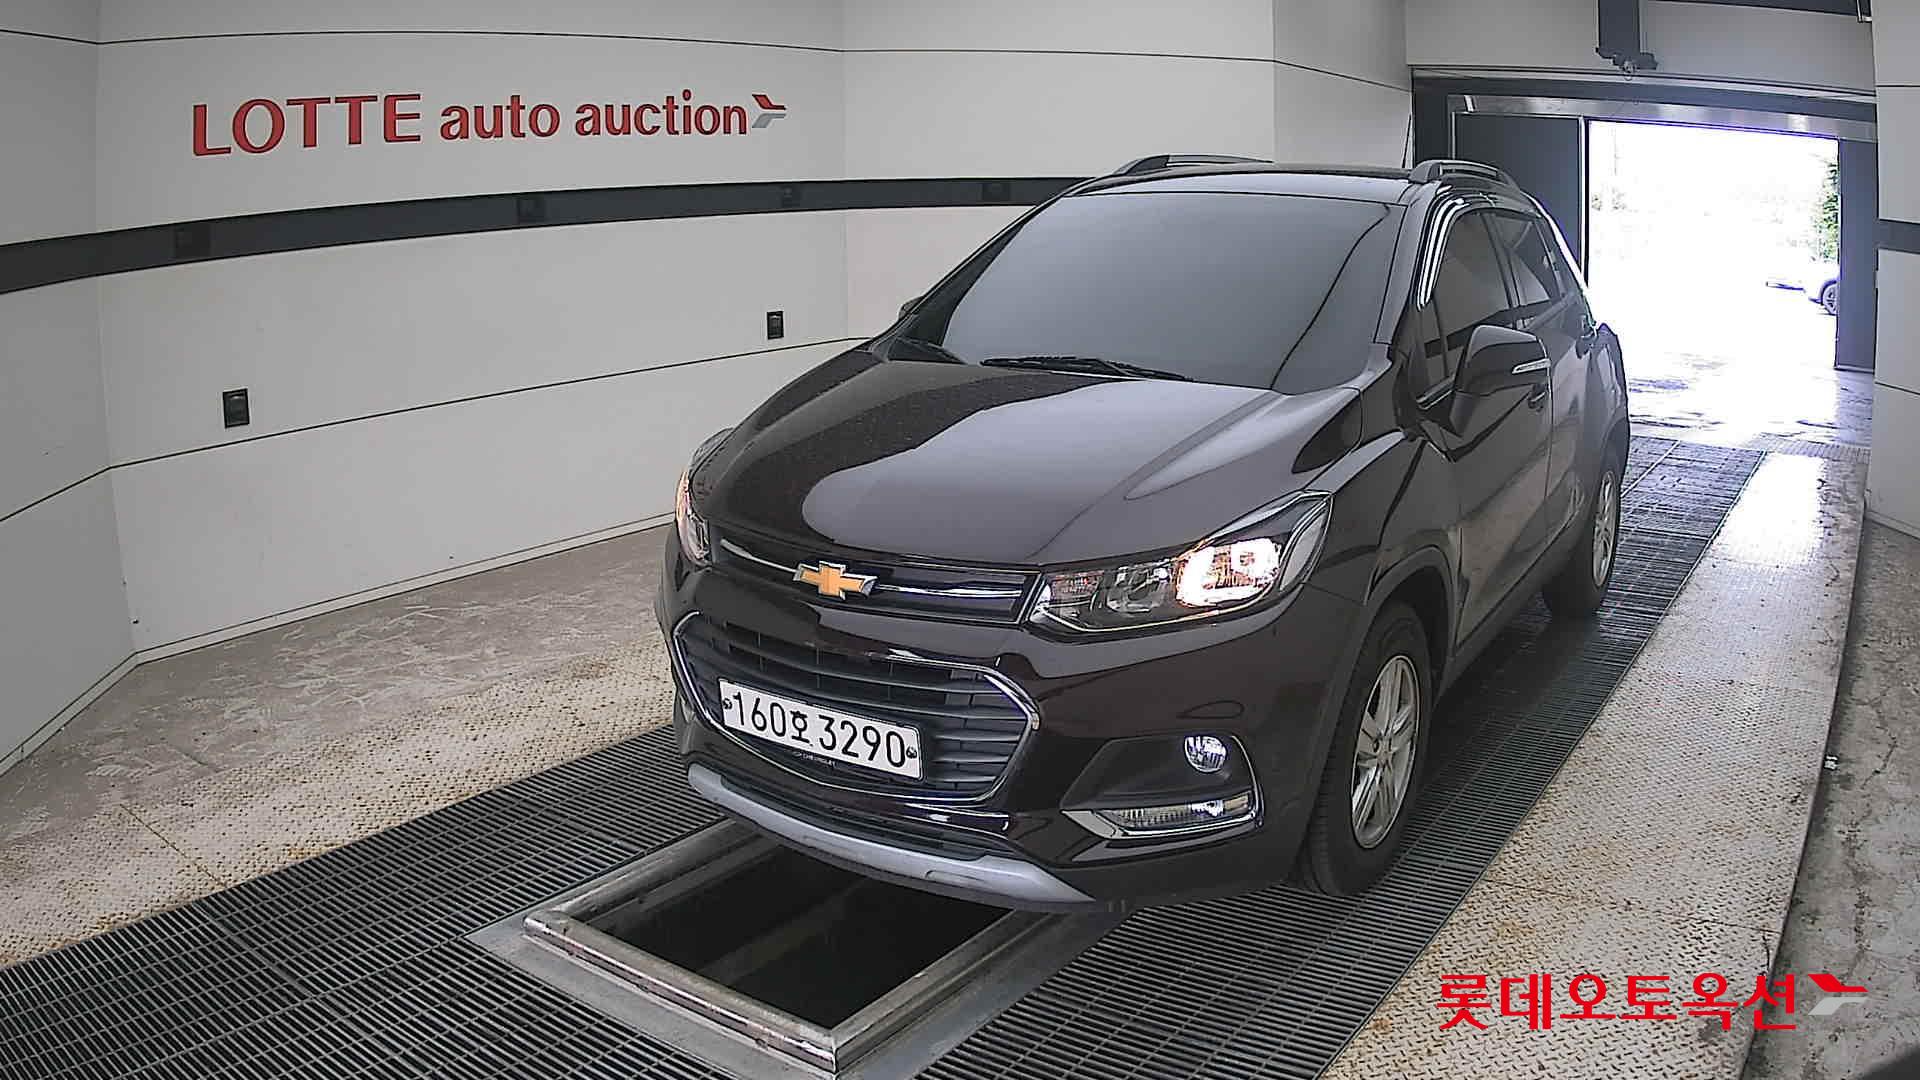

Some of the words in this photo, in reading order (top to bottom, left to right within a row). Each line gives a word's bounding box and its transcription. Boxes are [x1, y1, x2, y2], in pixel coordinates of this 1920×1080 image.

[192, 94, 421, 156] LOTTE
[440, 94, 560, 140] auto
[575, 90, 748, 136] auction
